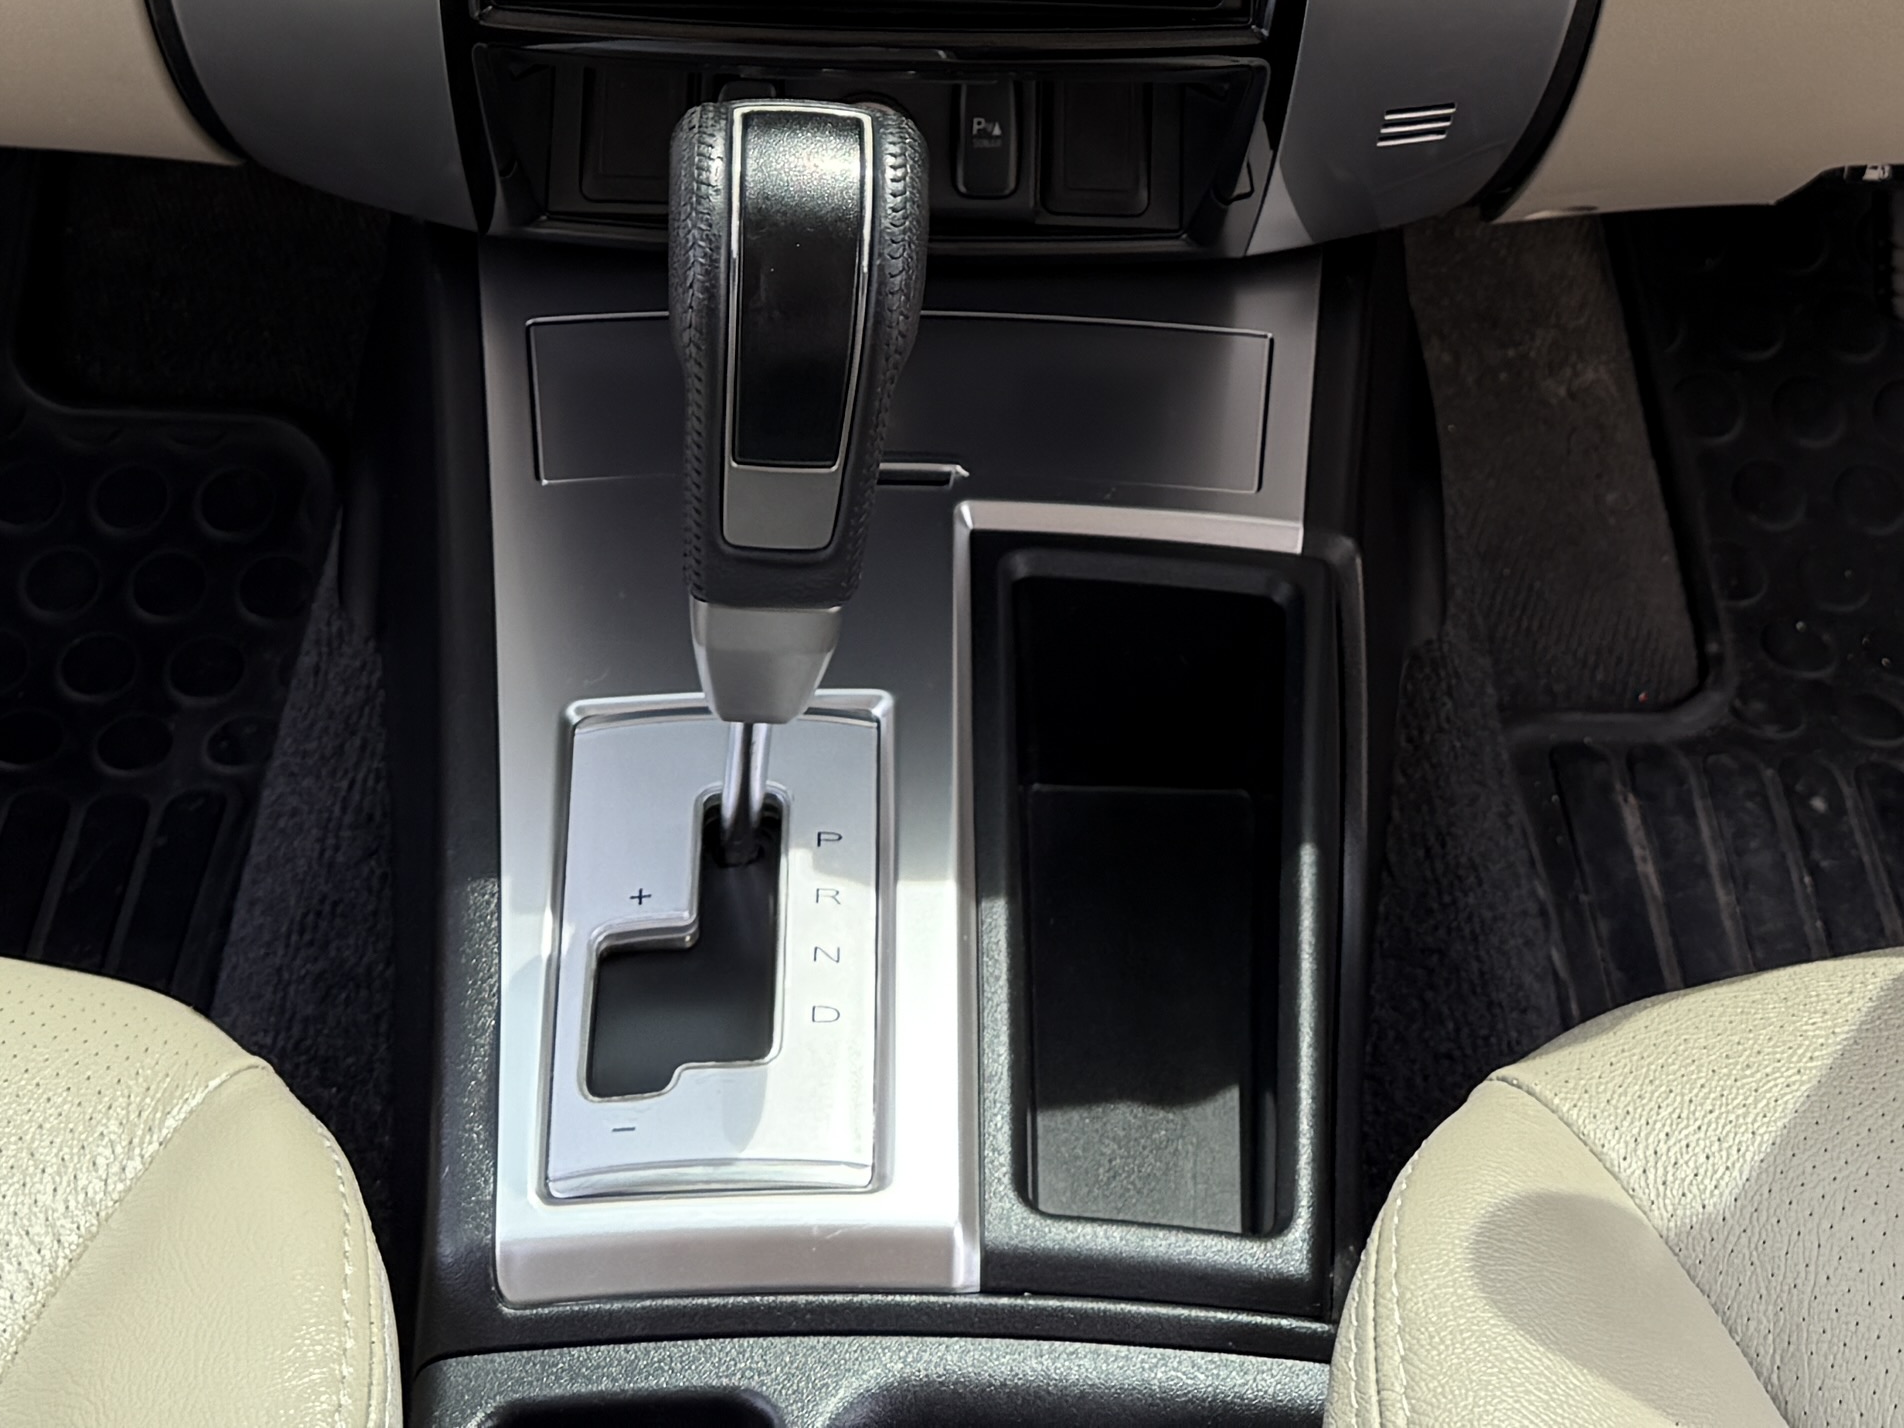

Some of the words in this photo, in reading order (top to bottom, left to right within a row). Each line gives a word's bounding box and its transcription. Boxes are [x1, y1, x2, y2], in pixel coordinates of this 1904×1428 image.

[817, 830, 843, 848] P
[815, 887, 841, 905] R
[813, 945, 840, 964] N
[811, 1004, 840, 1023] D
